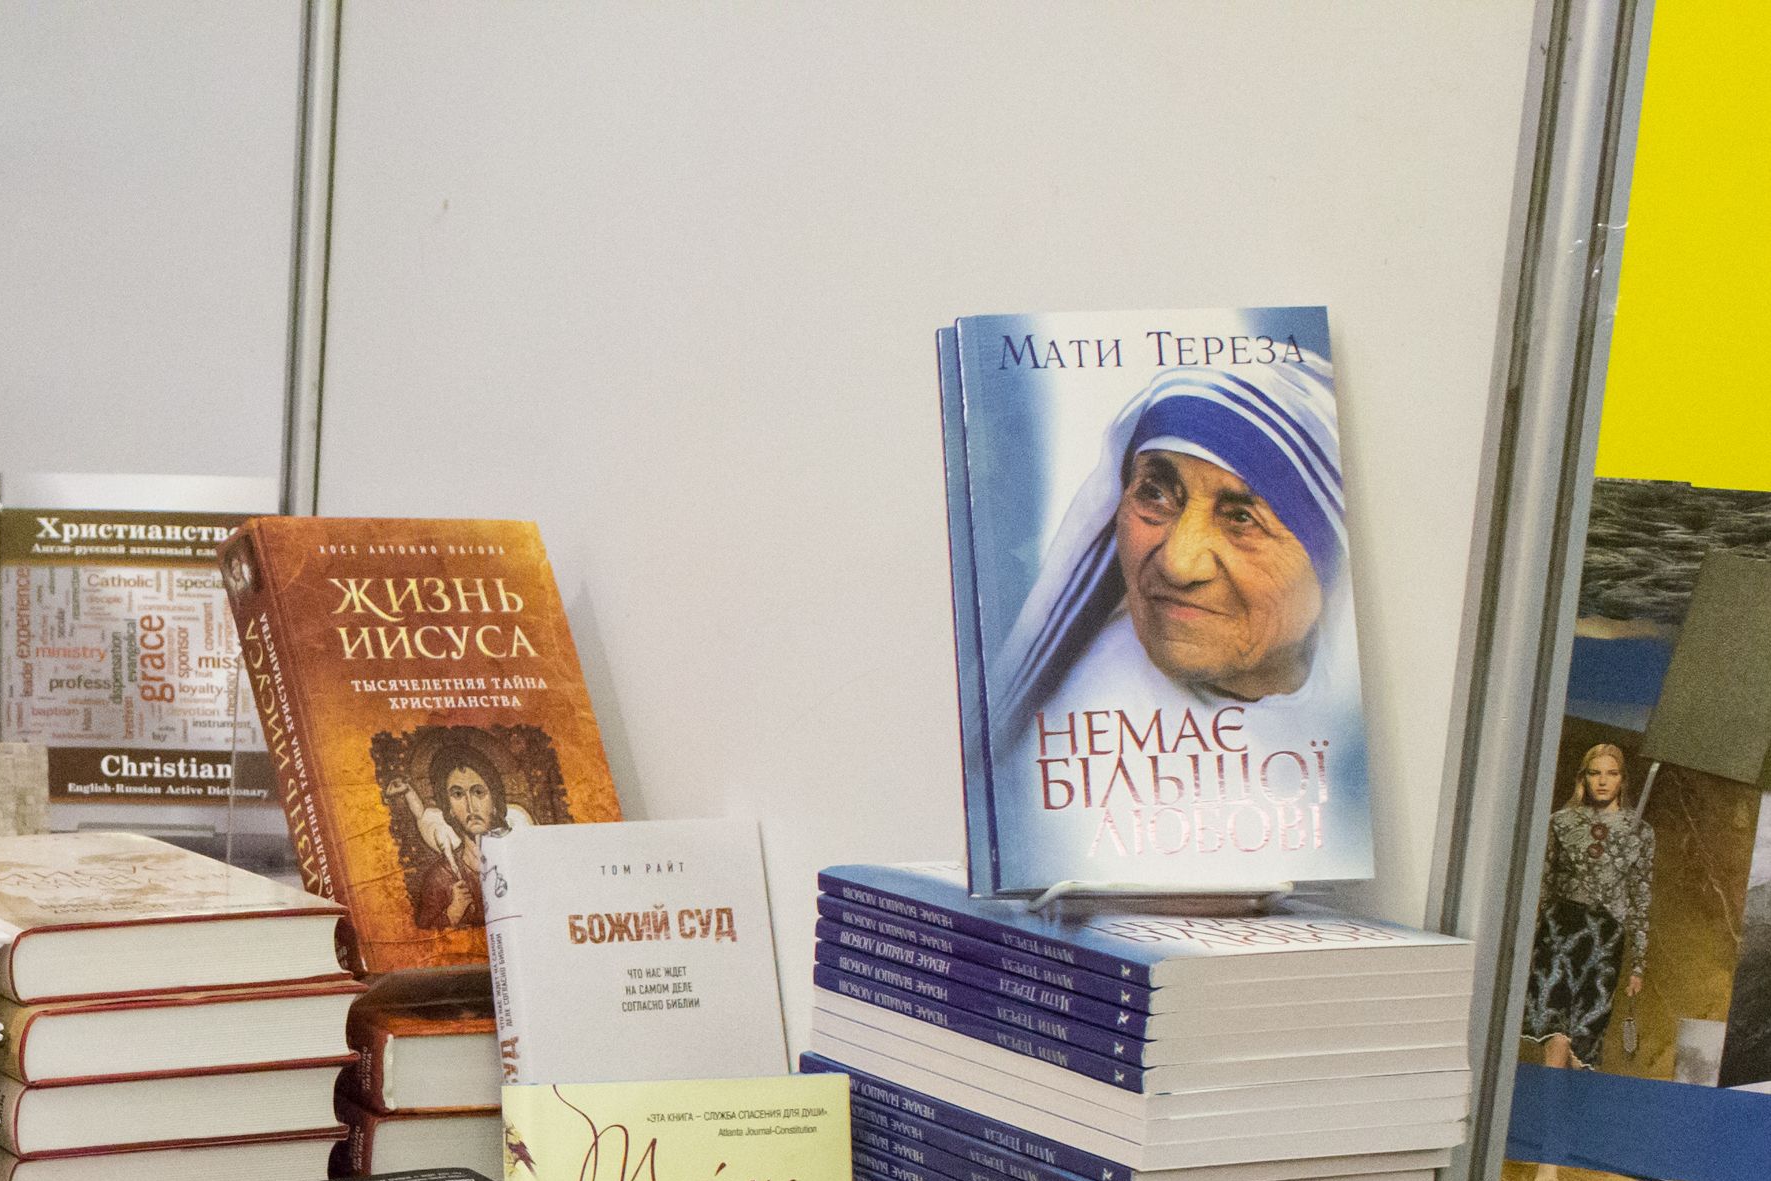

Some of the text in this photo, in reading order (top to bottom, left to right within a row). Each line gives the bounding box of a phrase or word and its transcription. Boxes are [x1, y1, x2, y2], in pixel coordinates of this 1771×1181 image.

[87, 573, 154, 588] Catholic
[328, 576, 525, 622] ЖИЗНЬ
[336, 624, 541, 661] ИИСУСА
[35, 646, 107, 662] ministry
[139, 613, 176, 704] grace
[350, 675, 549, 693] ТЫСЯЧЕЛЕТНЯЯ ТАЙНА
[388, 694, 522, 709] ХРИСТИАНСТВА
[1034, 706, 1249, 757] НЕМАЄ
[100, 754, 233, 779] Christian
[1035, 740, 1330, 811] БІЛЬШОЇ
[67, 782, 269, 798] English-Russian Active Dictionary
[1085, 804, 1325, 858] ЛЮБОВІ
[600, 861, 685, 876] ТОМ РАЙТ
[567, 903, 738, 945] БОЖИЙ СУД
[627, 966, 687, 978] ЧТО НАС ЖДЕТ
[625, 982, 693, 995] НА САМОМ ДЕЛЕ
[622, 998, 701, 1012] СОГЛАСНО БИБЛИИ
[703, 1110, 737, 1121] СЛУЖБА
[738, 1109, 782, 1120] СПАСЕНИЯ
